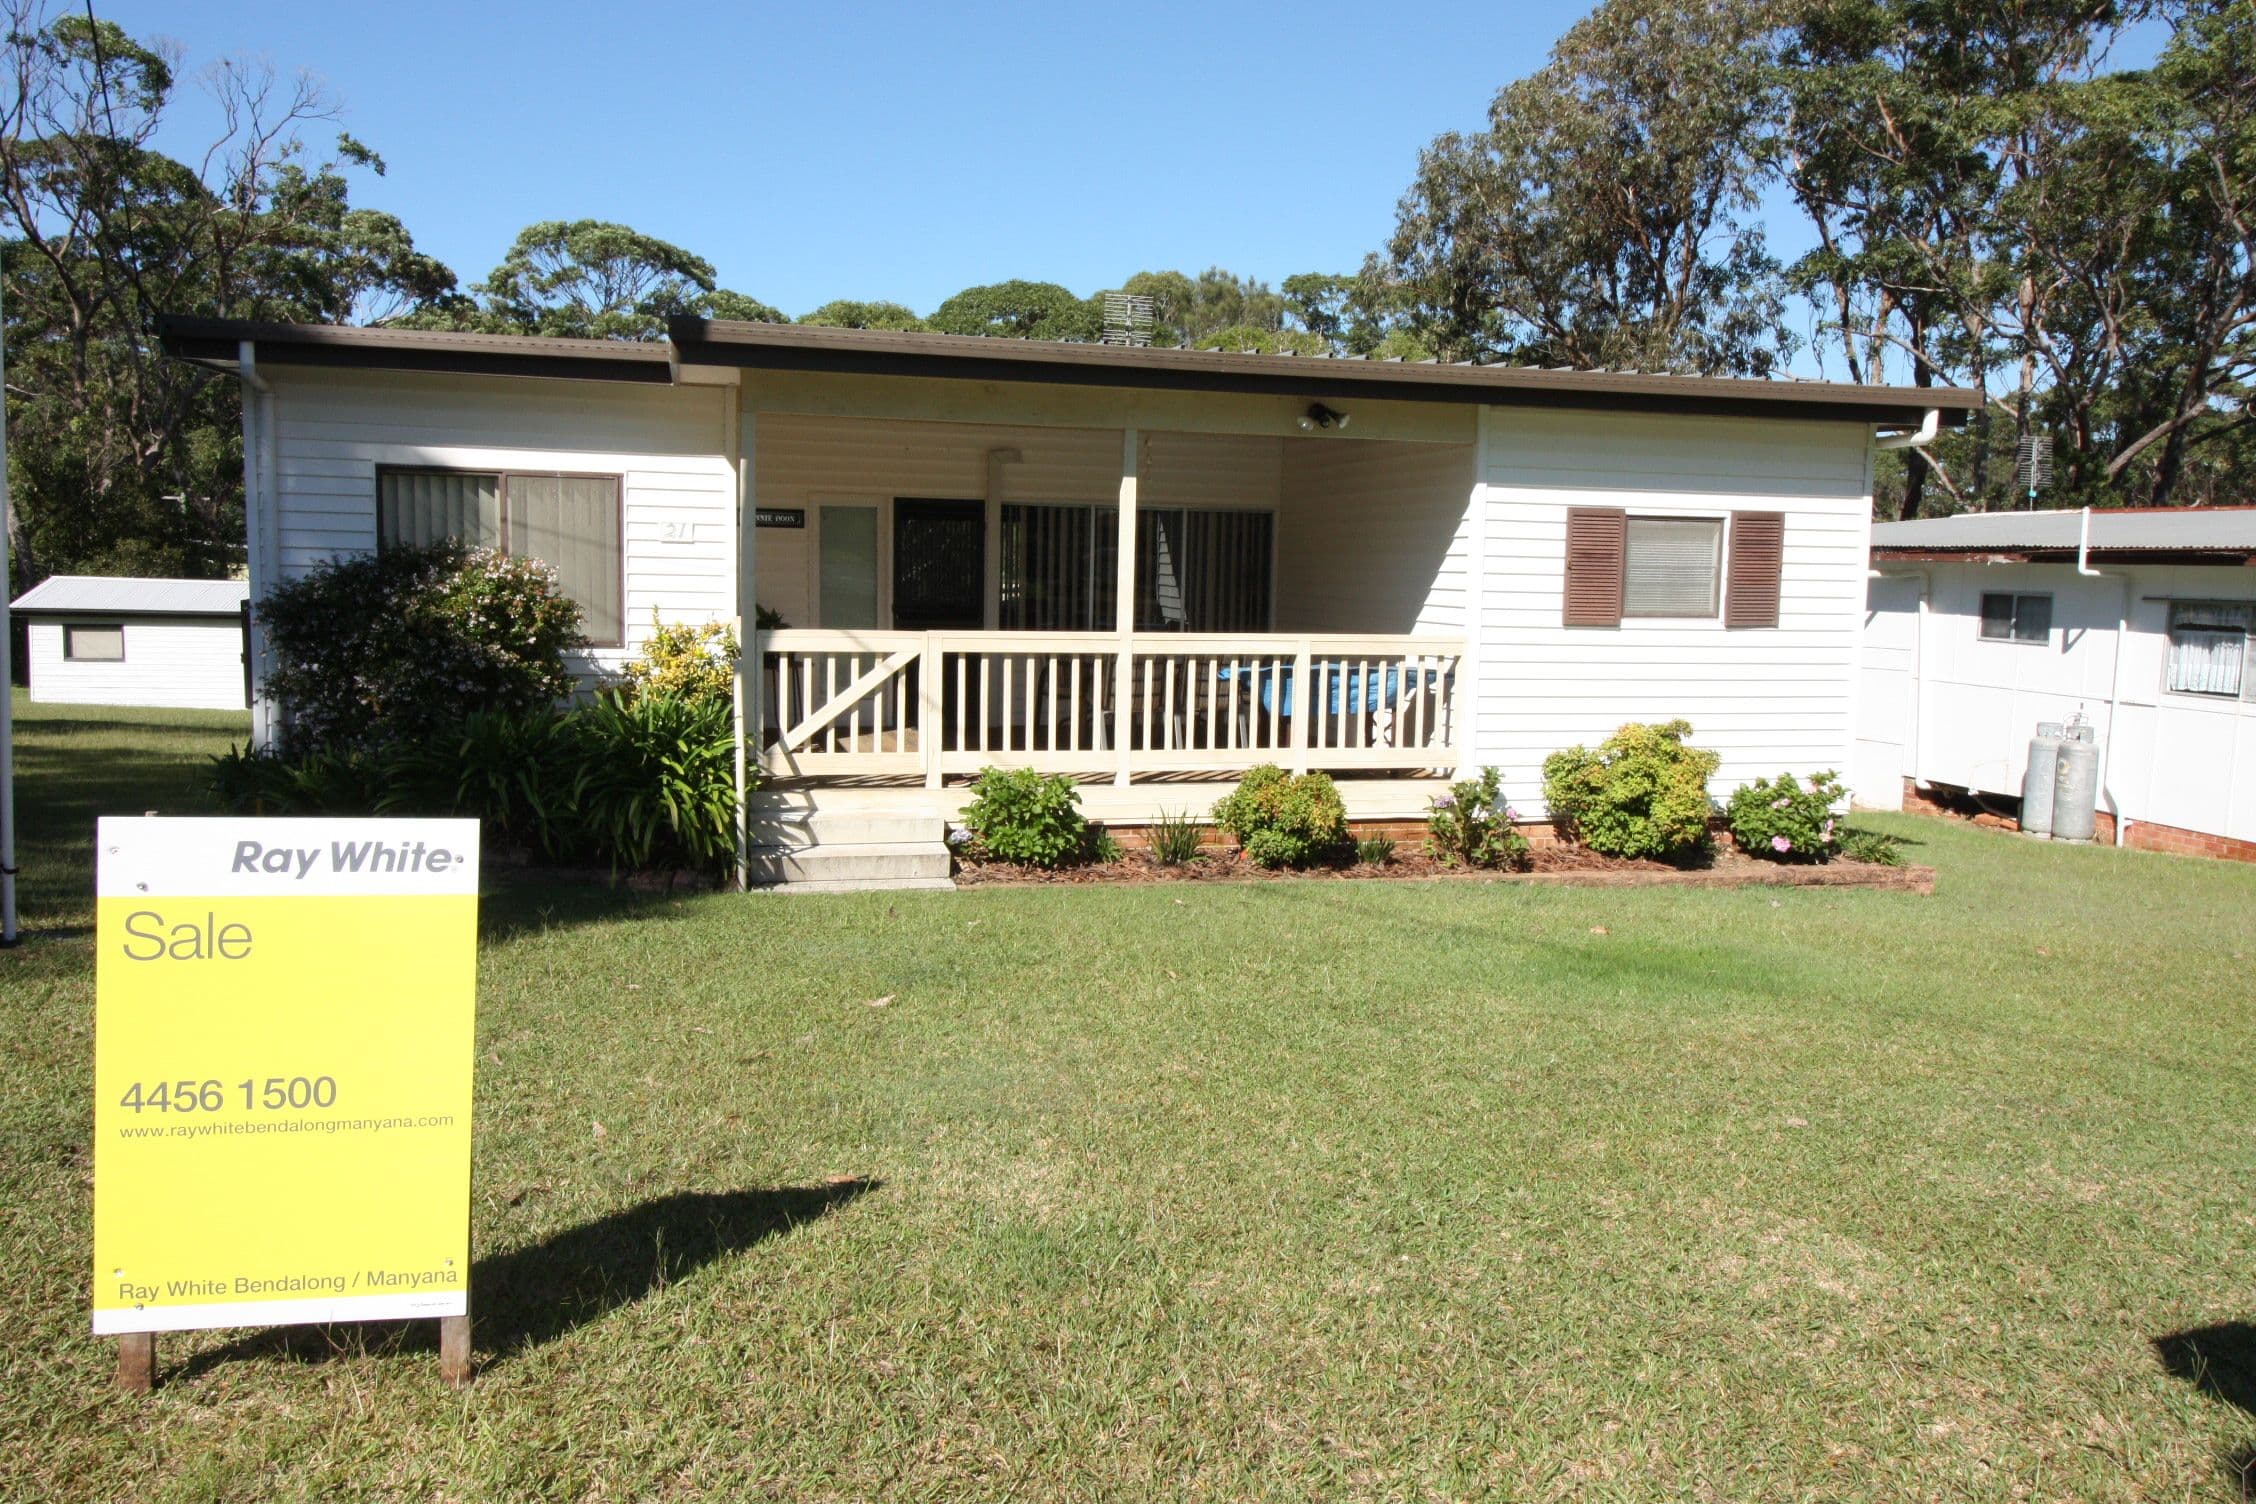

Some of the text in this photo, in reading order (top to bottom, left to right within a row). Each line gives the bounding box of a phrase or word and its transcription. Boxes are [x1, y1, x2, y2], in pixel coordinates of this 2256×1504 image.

[232, 840, 452, 879] Ray White
[123, 911, 252, 961] Sale
[120, 1076, 337, 1113] 4456 1500
[119, 1115, 454, 1139] www.raywhitebendalongmanyana.com
[119, 1283, 159, 1302] Ray
[167, 1279, 227, 1297] White
[234, 1275, 346, 1293] Bendalong
[367, 1269, 457, 1288] Manyana
